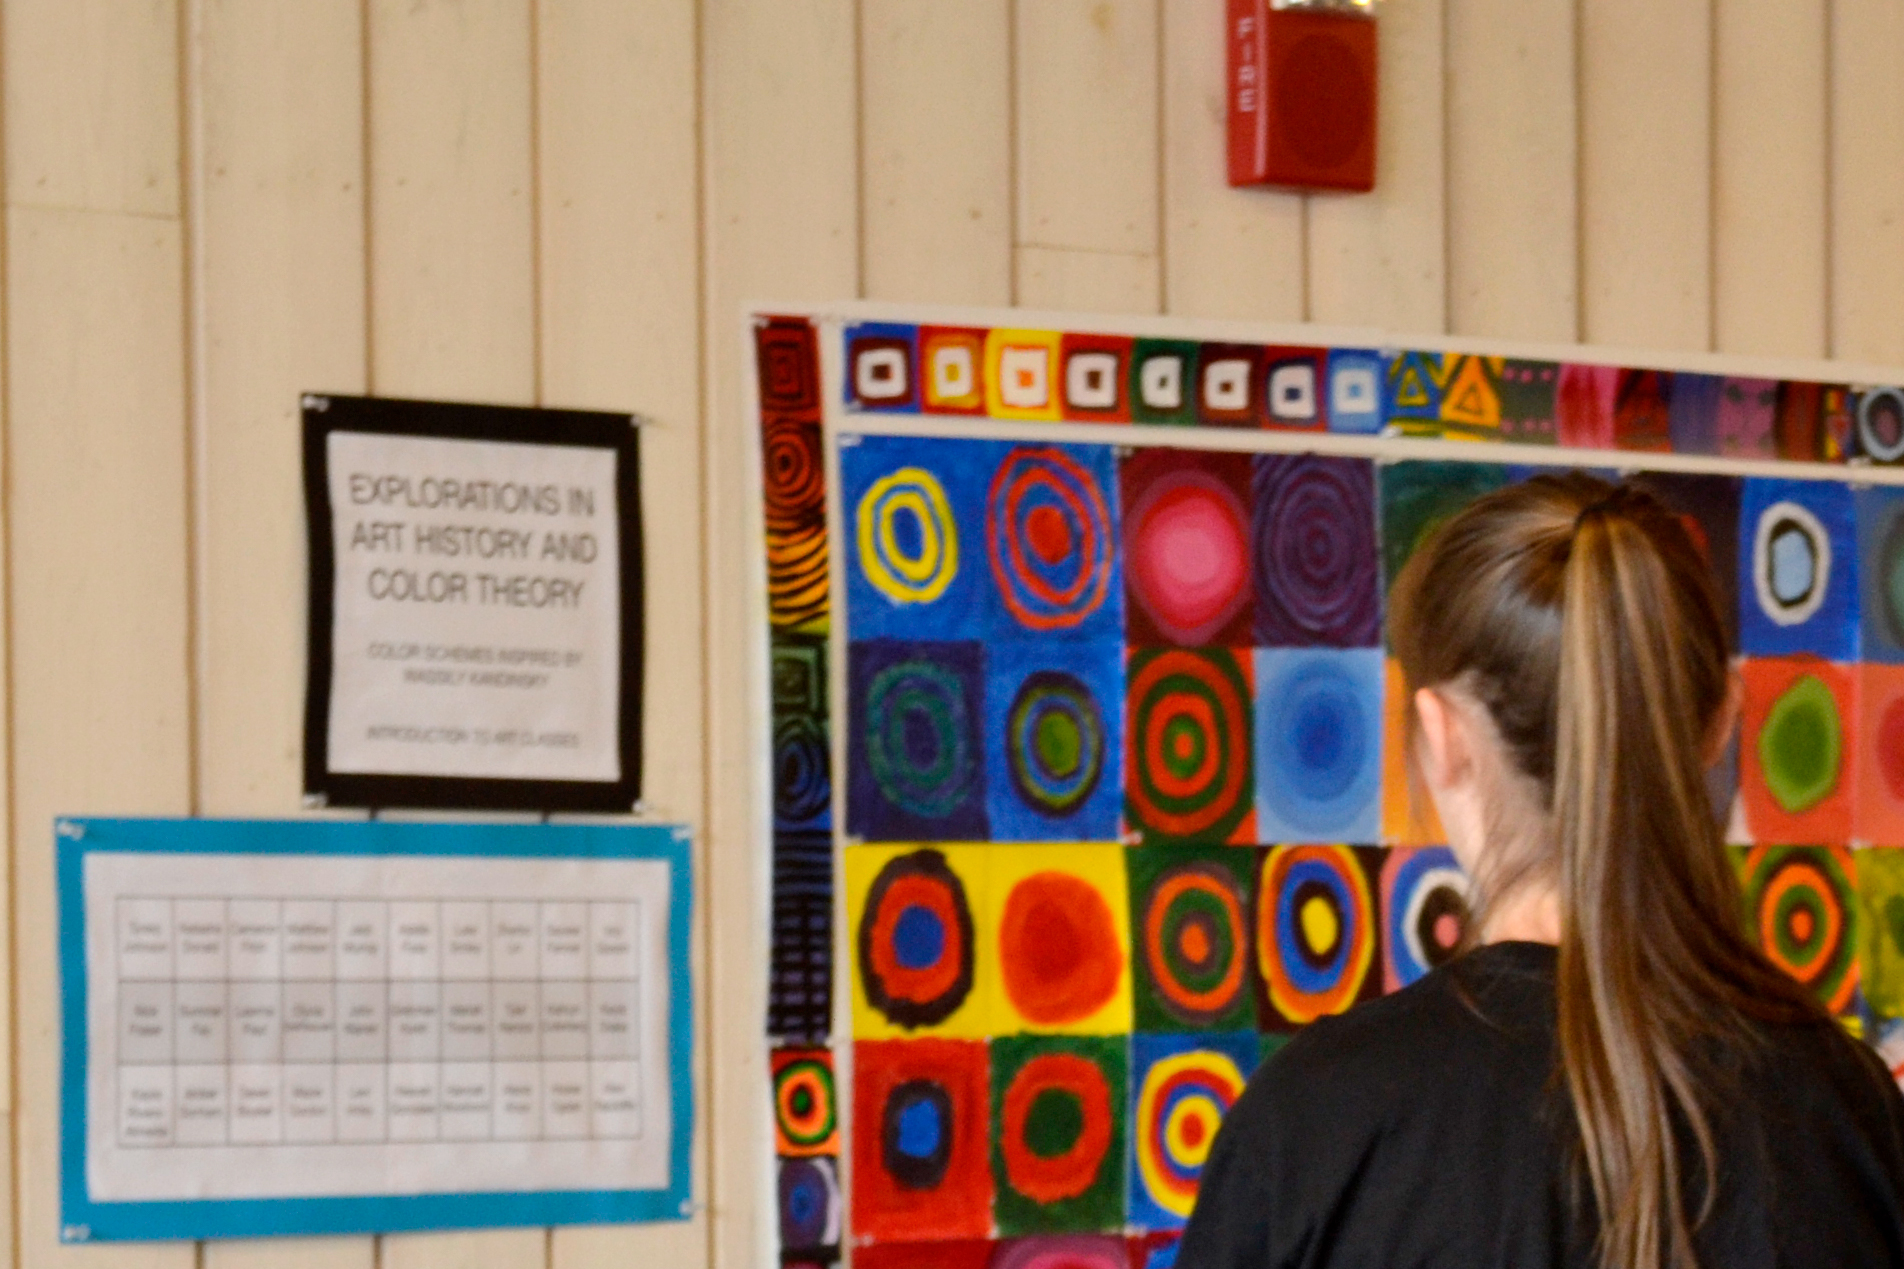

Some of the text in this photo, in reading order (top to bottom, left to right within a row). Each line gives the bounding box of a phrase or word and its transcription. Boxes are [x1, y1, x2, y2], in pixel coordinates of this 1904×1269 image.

[1237, 17, 1256, 113] FIRE
[350, 473, 595, 518] EXPLORATIONS IN
[351, 522, 598, 565] ART HISTORY AND
[368, 569, 586, 608] COLOR THEORY
[369, 642, 420, 660] COLOR
[427, 645, 494, 664] SCHEMES
[368, 725, 468, 745] INTRODUCTION
